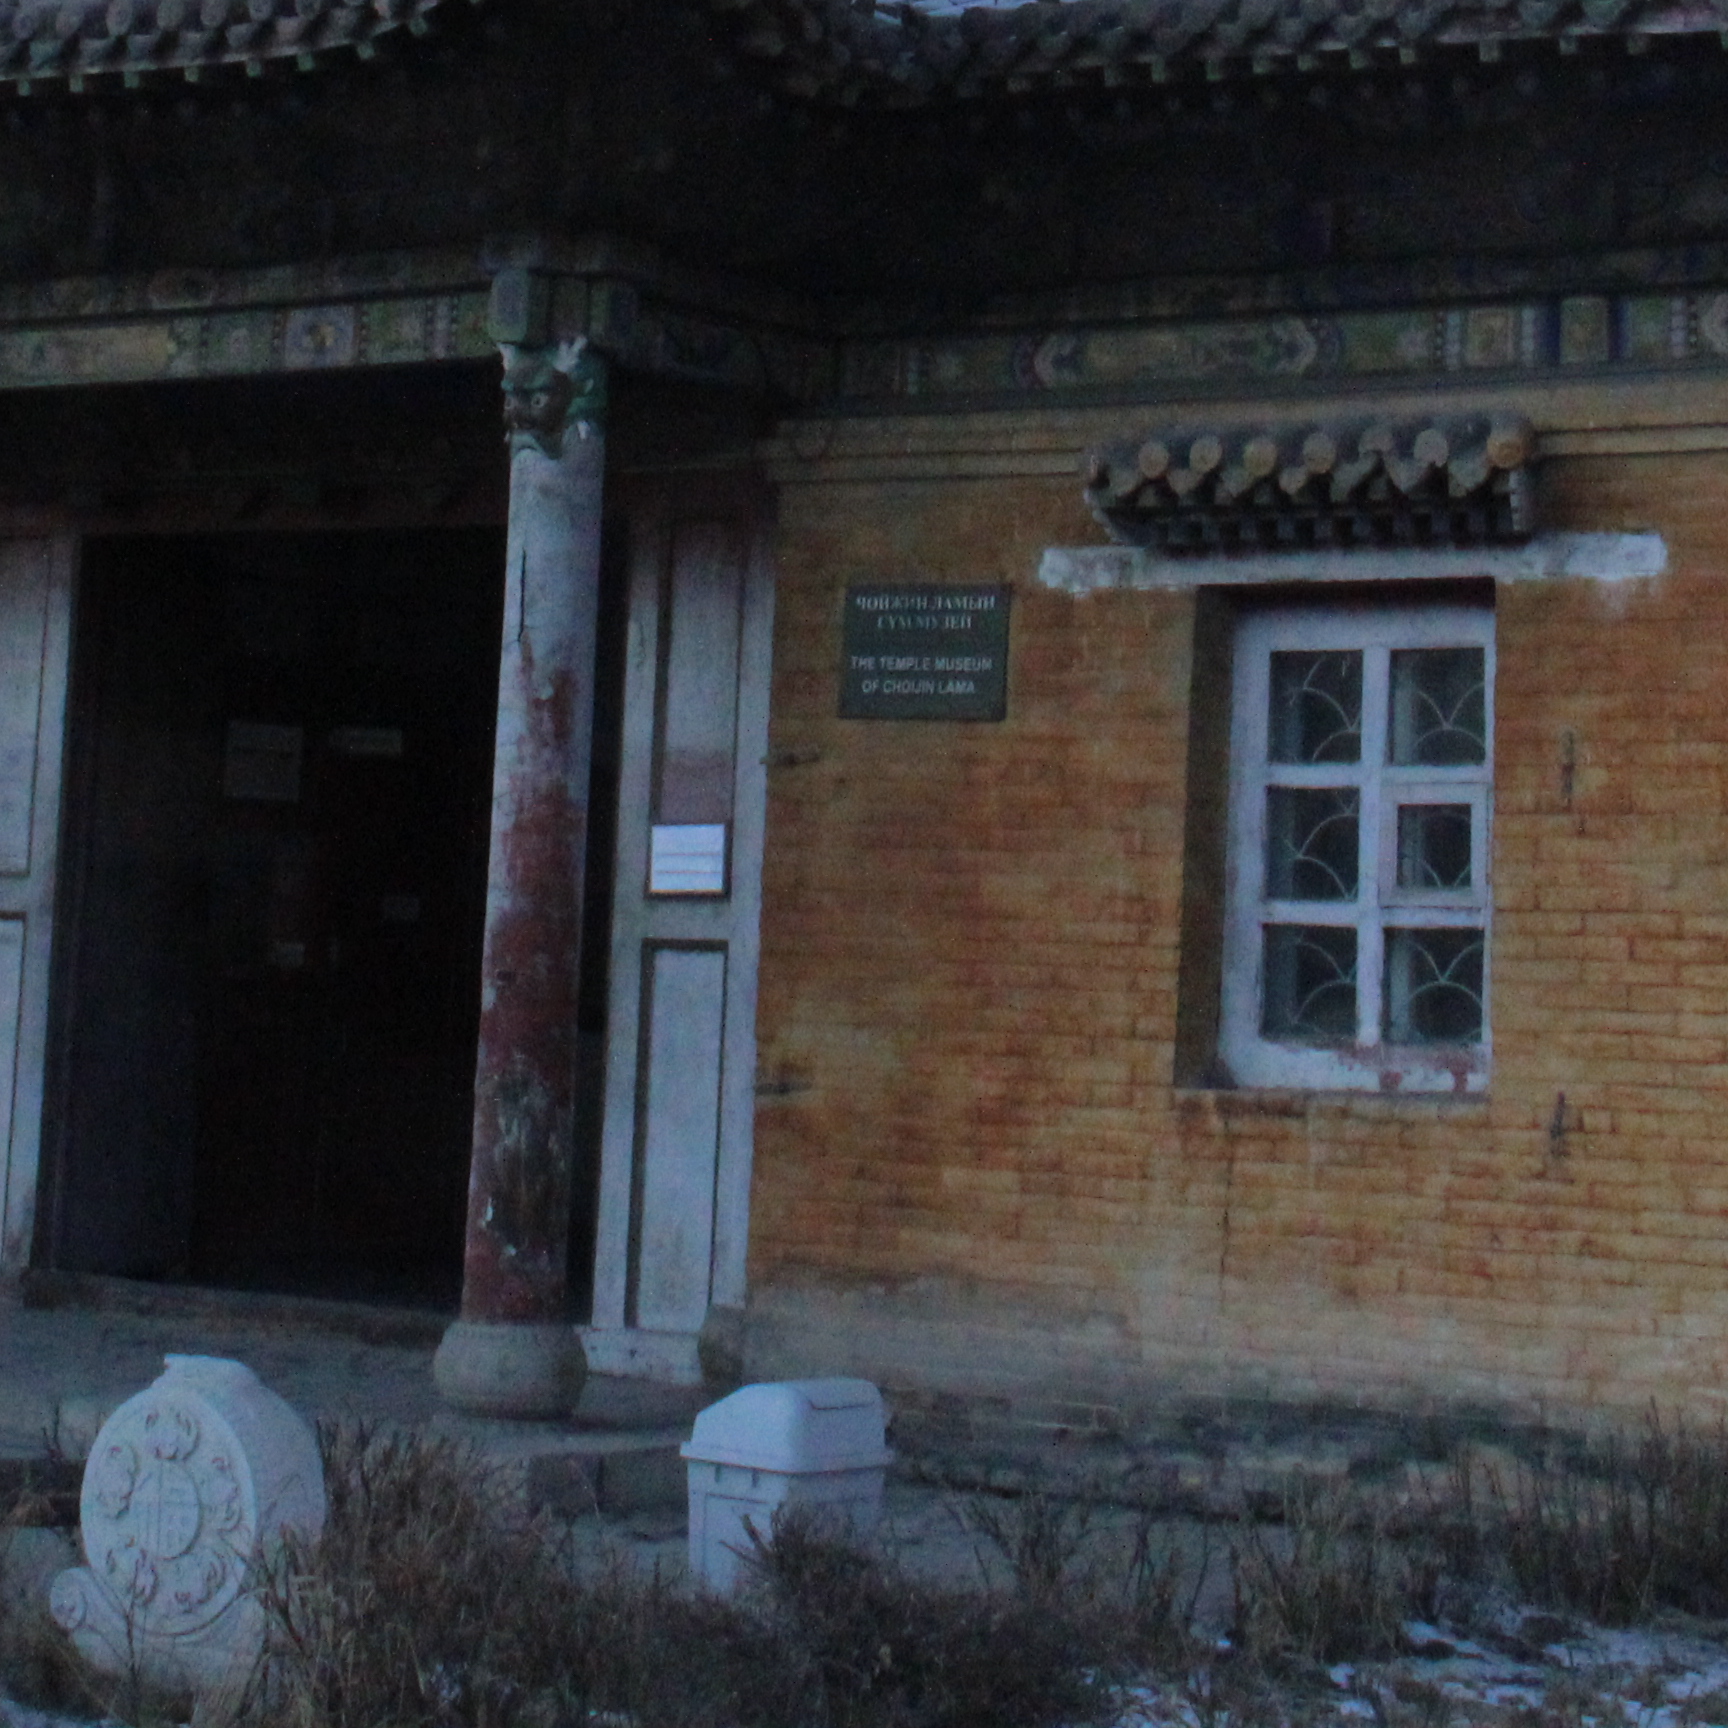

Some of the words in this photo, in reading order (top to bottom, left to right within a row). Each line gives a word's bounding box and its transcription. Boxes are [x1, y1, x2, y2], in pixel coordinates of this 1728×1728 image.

[851, 655, 875, 670] THE
[880, 656, 930, 670] TEMPLE
[935, 656, 992, 671] MUSEUM
[861, 679, 879, 693] OF
[883, 679, 934, 694] CHOIJIN
[938, 680, 976, 694] LAMA
